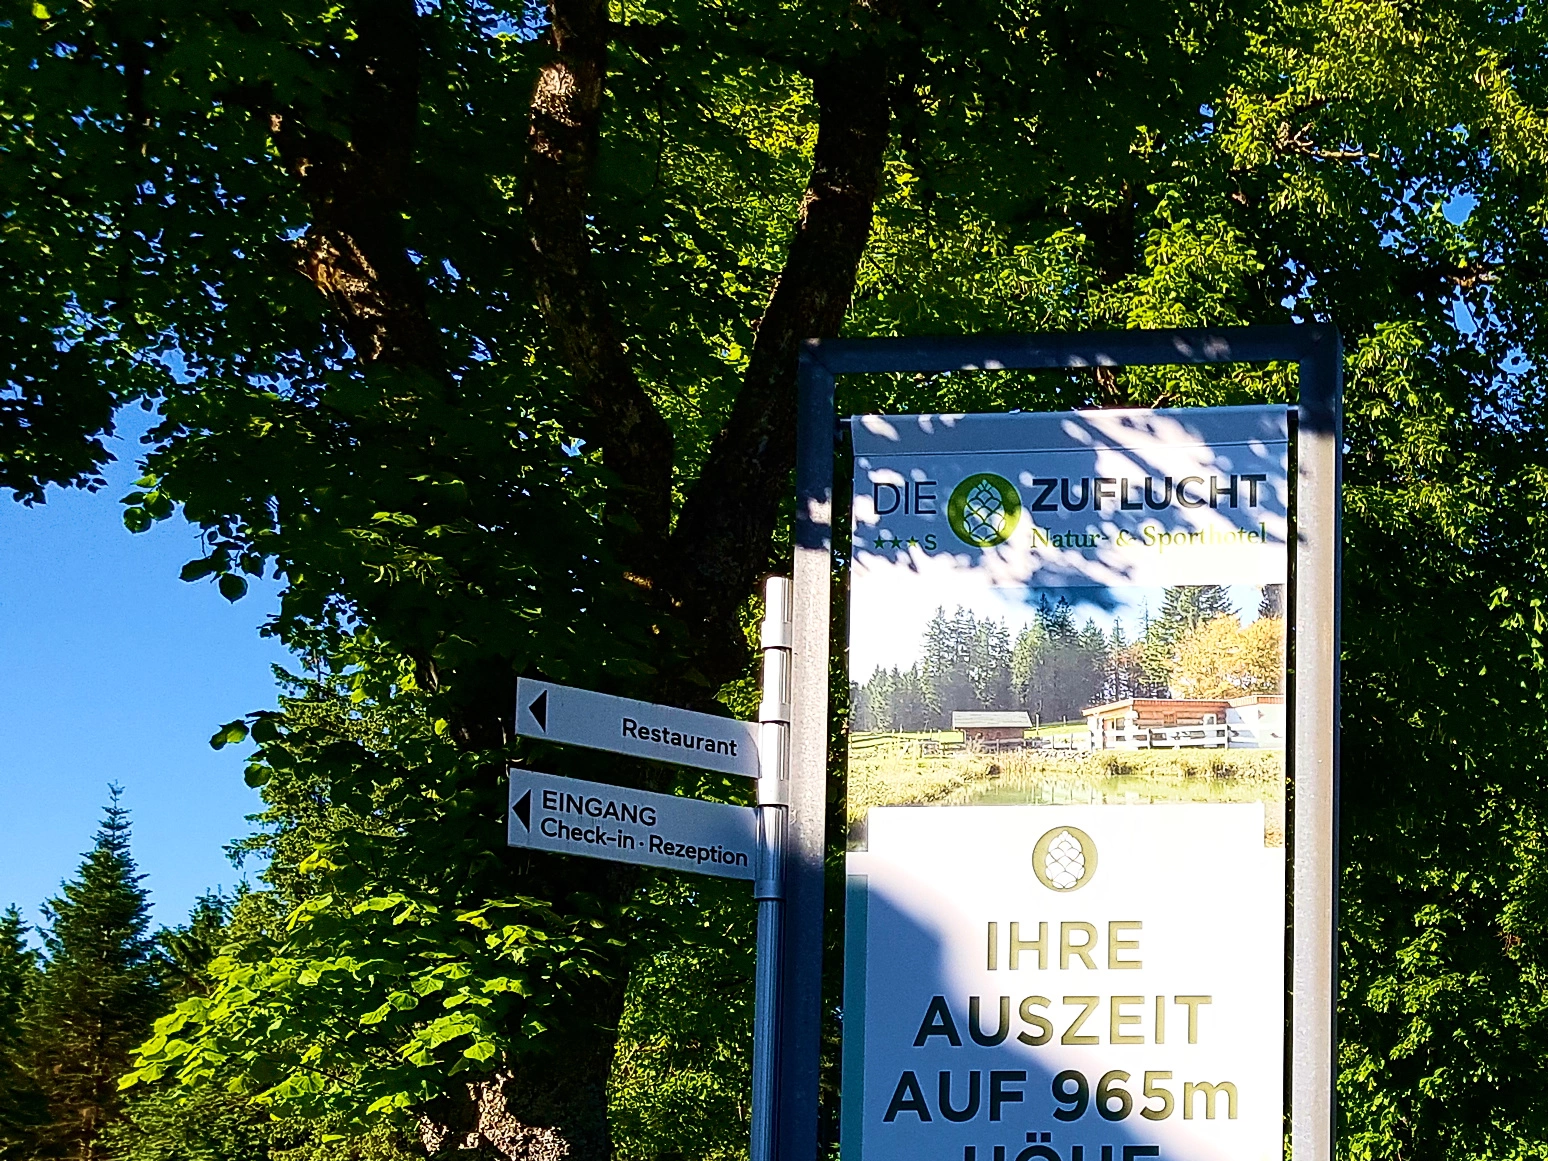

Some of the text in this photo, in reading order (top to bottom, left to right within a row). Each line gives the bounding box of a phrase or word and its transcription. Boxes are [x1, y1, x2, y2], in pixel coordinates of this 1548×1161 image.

[873, 474, 1267, 516] DIE ZUFLUCHT
[1030, 522, 1267, 554] Natur- & Sporthotel
[622, 717, 738, 757] Restaurant
[542, 789, 657, 826] EINGANG
[540, 817, 635, 850] Check-in
[648, 835, 748, 867] Rezeption
[986, 921, 1144, 972] IHRE
[913, 995, 1213, 1048] AUSZEIT
[882, 1069, 1239, 1123] AUF 965m
